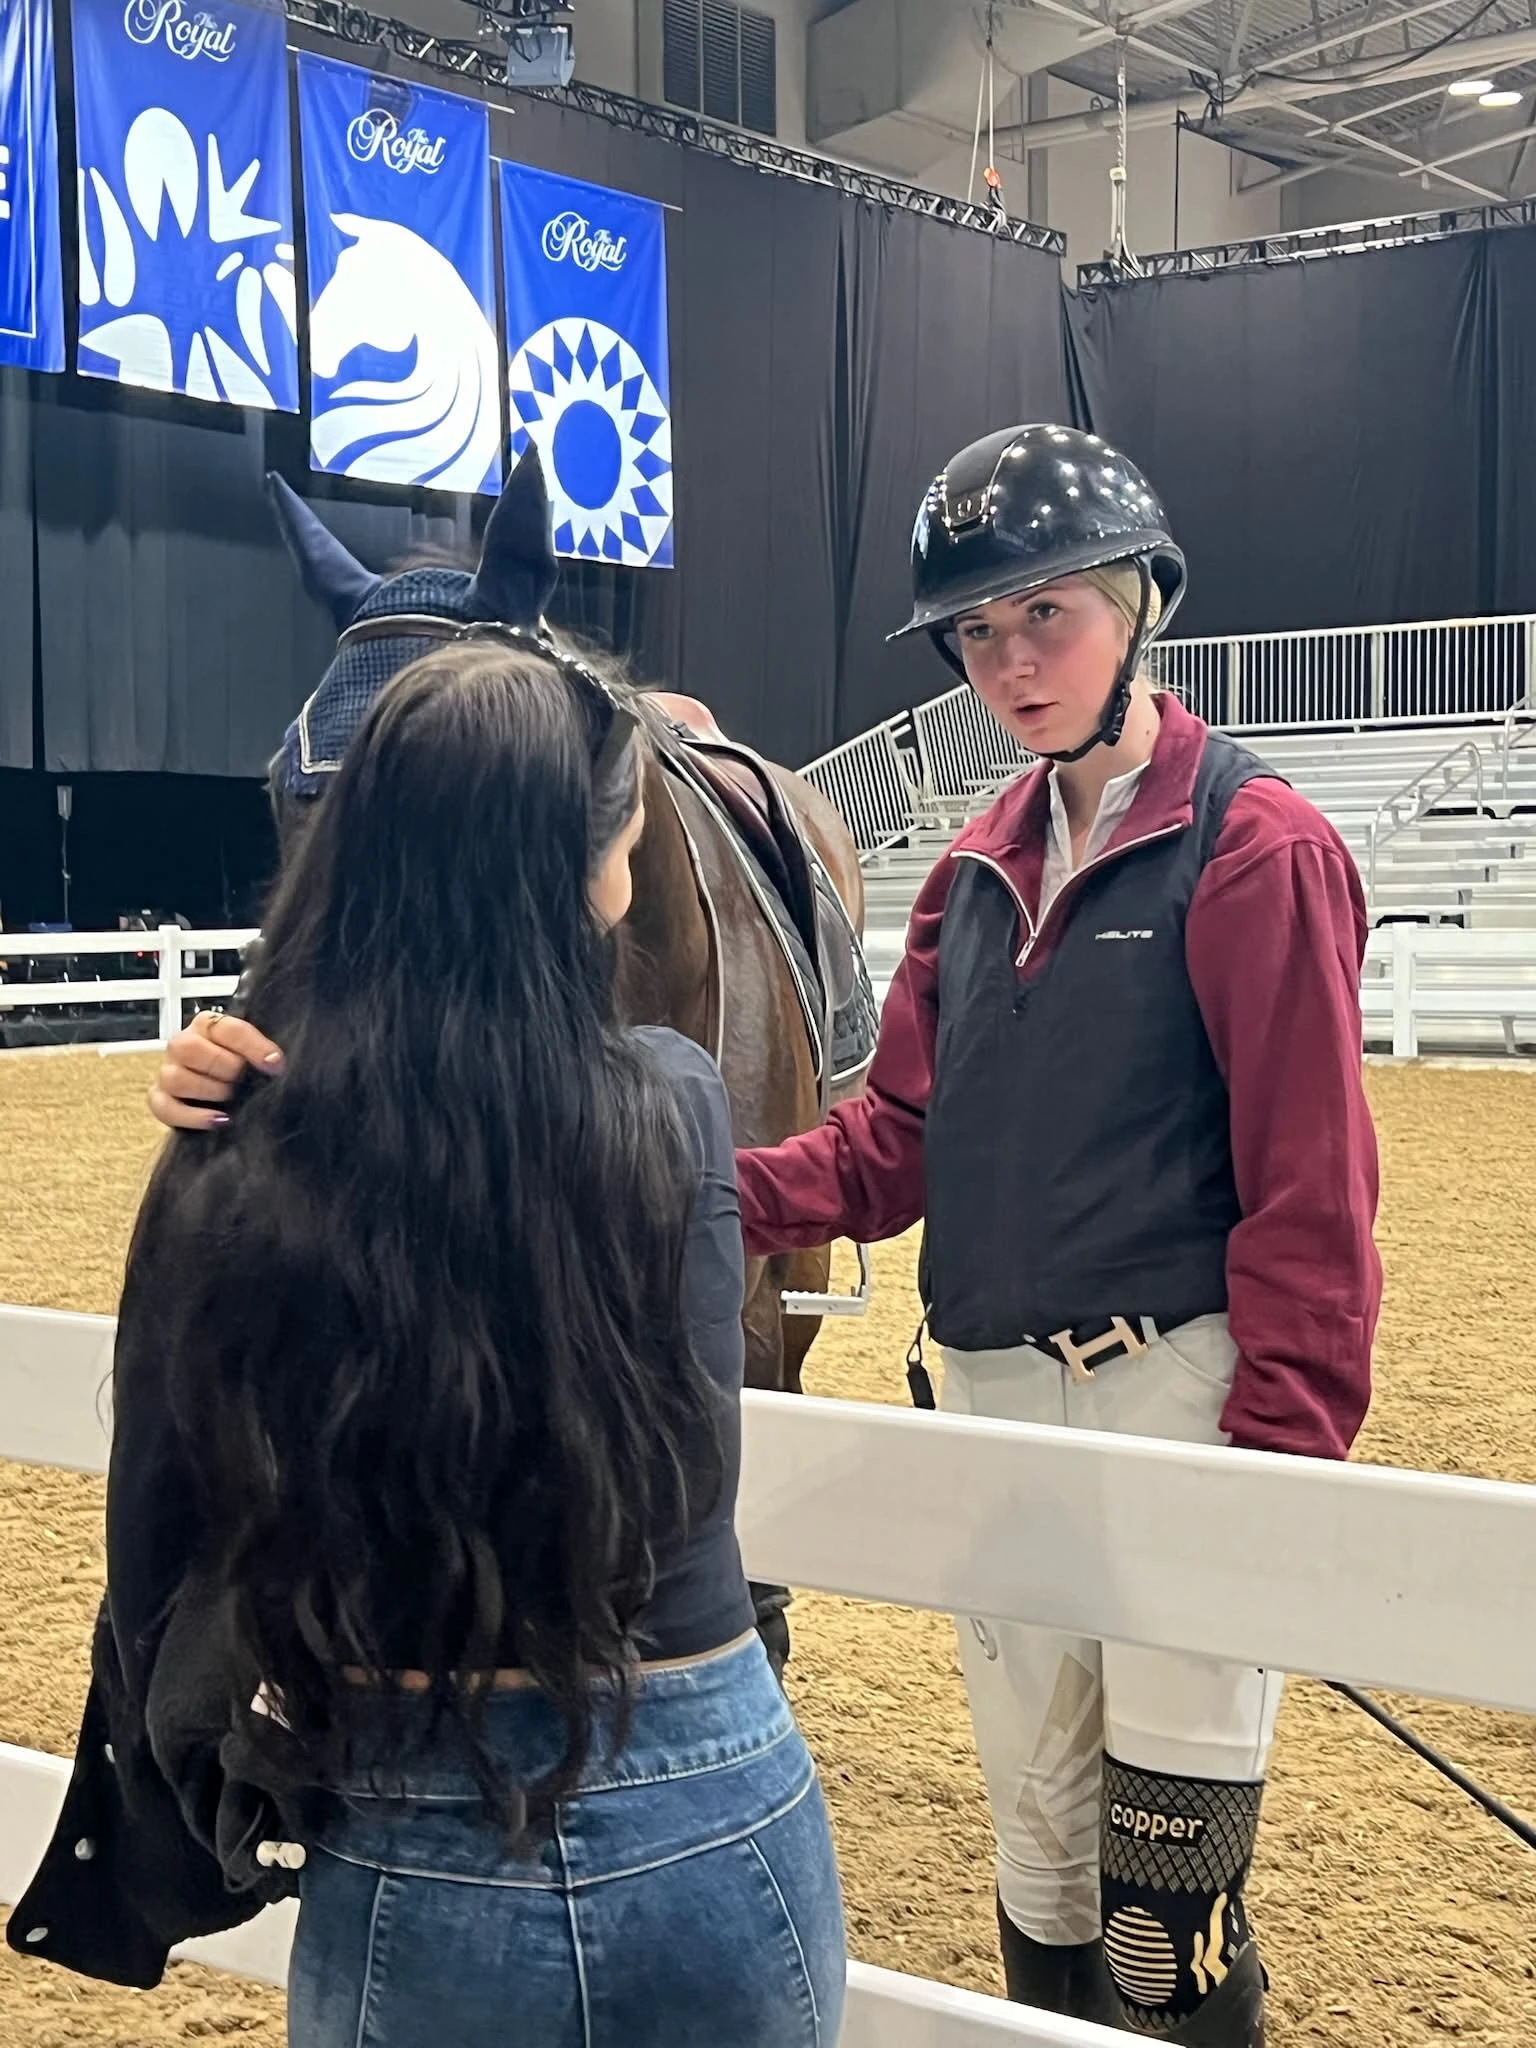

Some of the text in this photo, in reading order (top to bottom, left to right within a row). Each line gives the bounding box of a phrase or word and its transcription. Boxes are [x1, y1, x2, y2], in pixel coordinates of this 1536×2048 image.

[124, 0, 237, 63] Royal
[346, 107, 447, 175] Royal
[541, 211, 628, 272] Royal
[1110, 1803, 1204, 1841] copper
